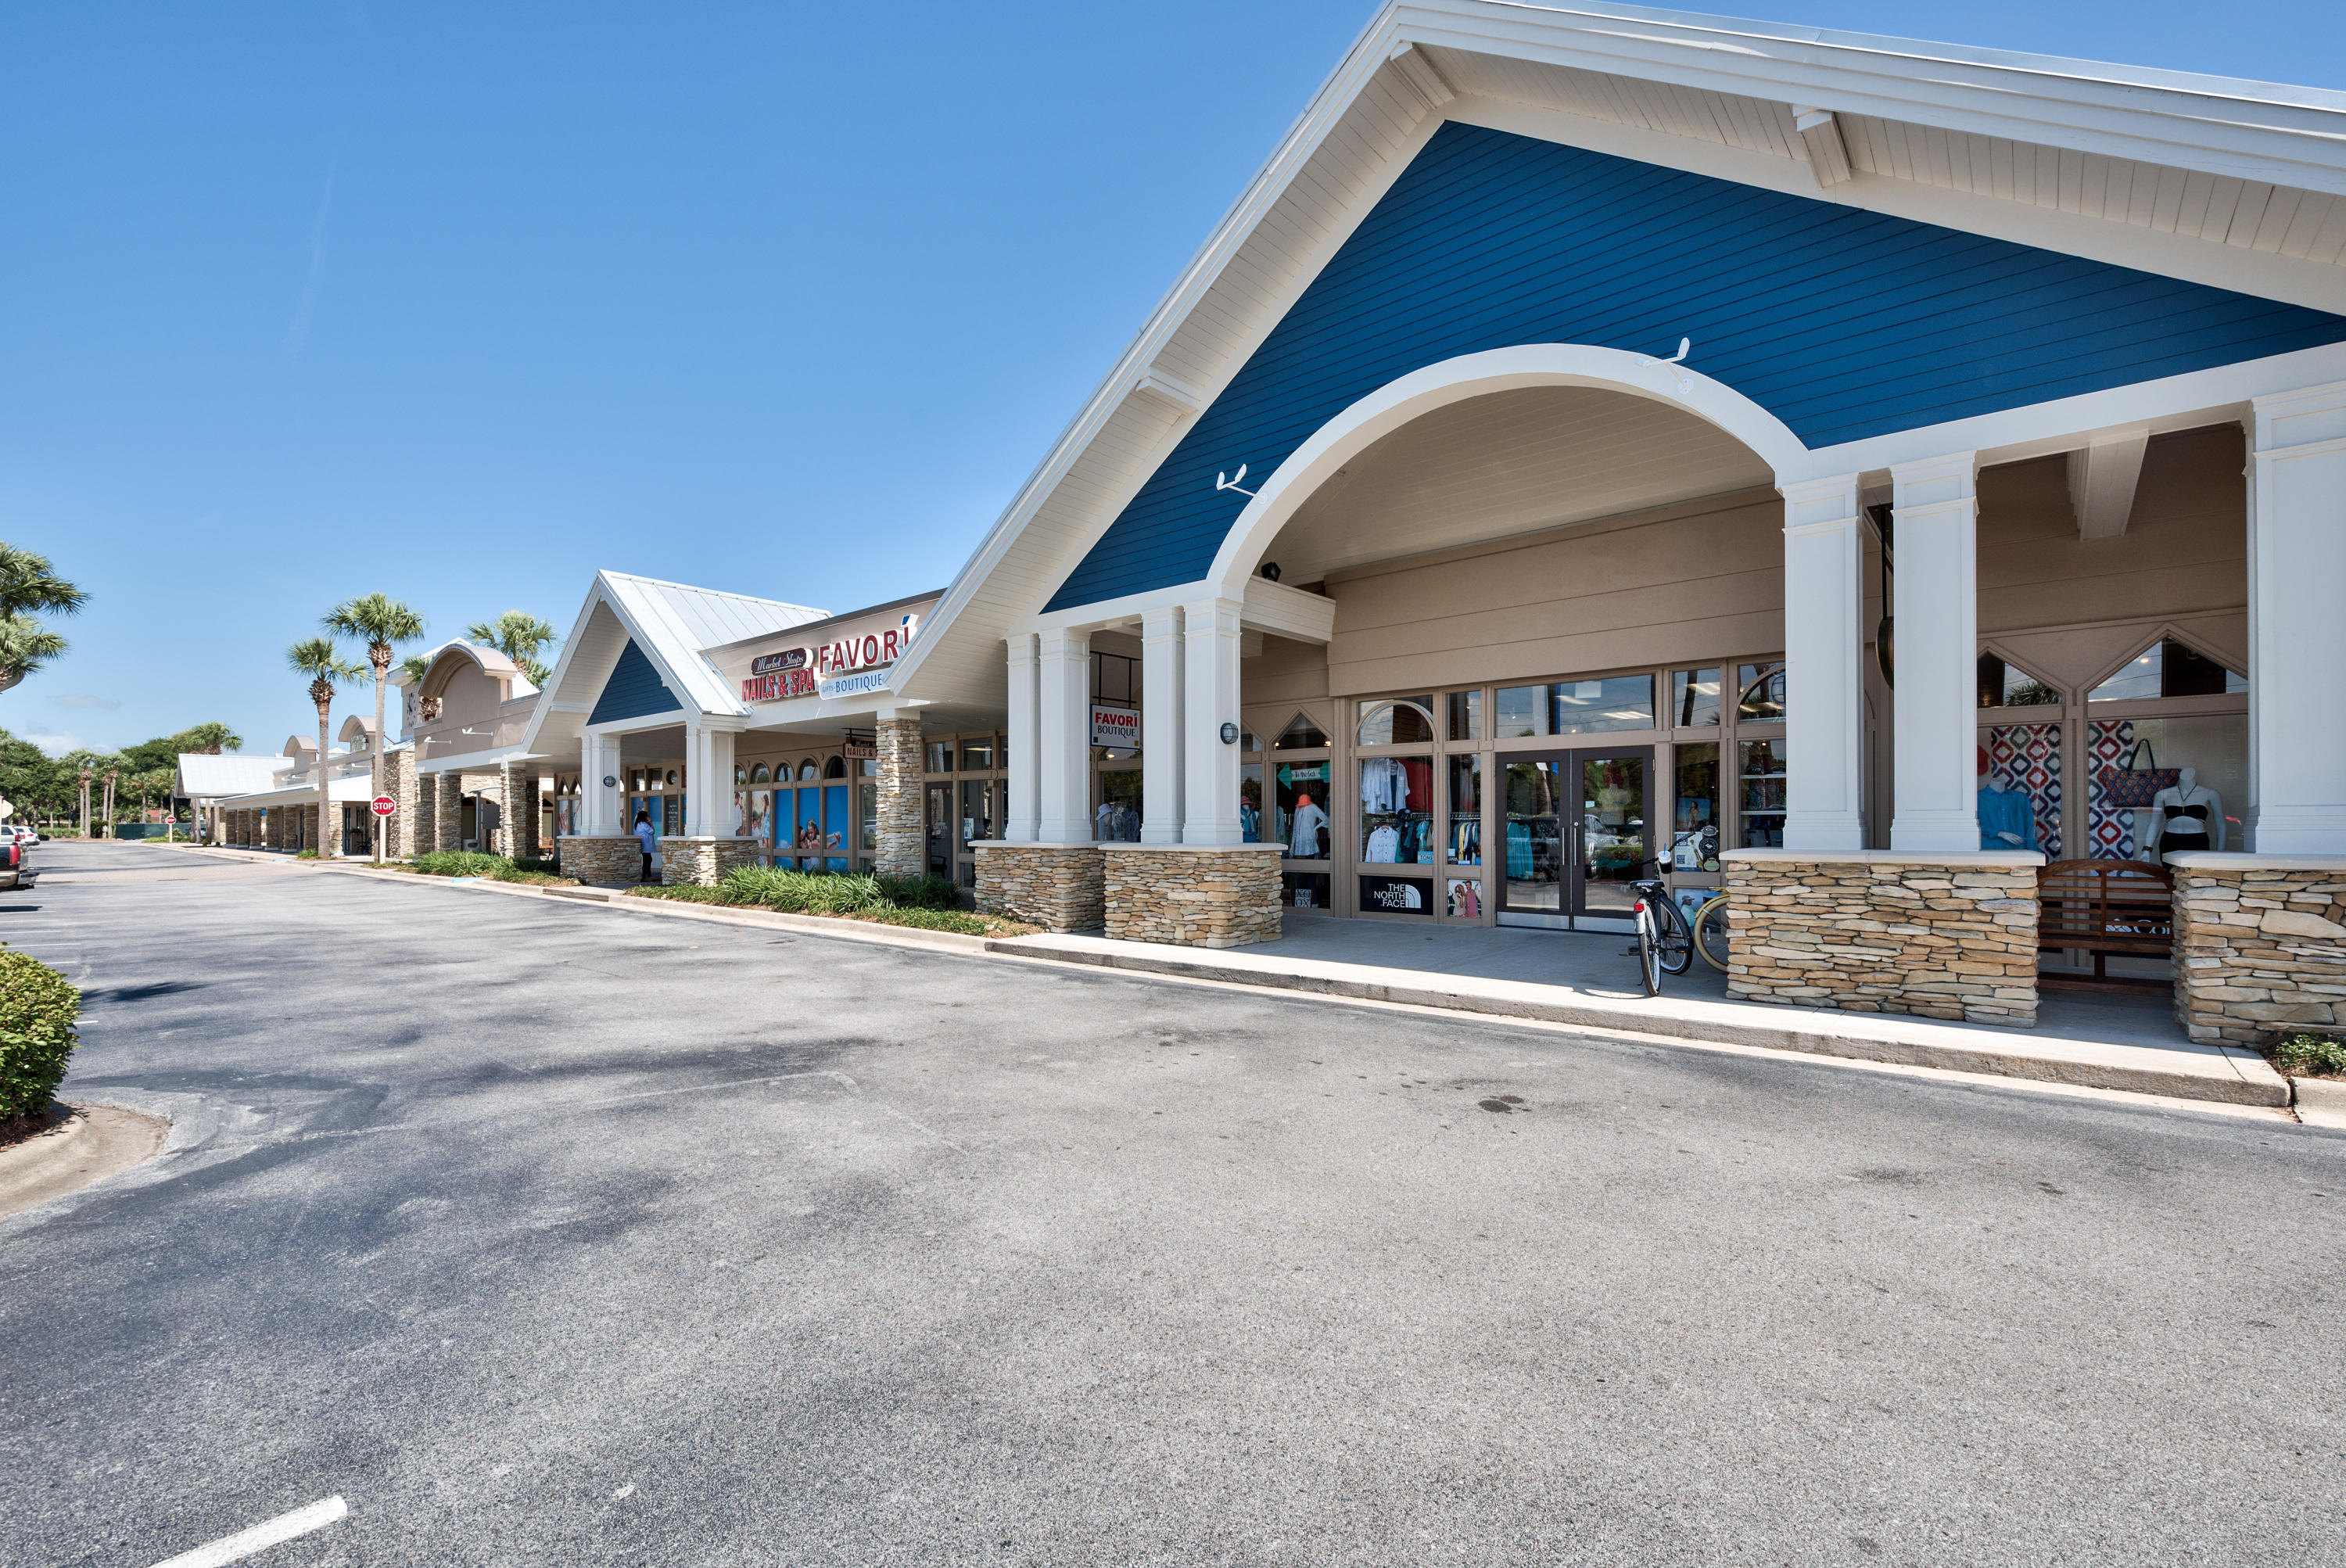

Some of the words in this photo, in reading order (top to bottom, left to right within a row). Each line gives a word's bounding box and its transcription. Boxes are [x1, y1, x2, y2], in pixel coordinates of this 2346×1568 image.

[755, 657, 781, 670] Market
[782, 651, 804, 666] Shops
[742, 675, 774, 701] NAILS
[778, 674, 787, 696] &
[791, 667, 814, 694] SPA
[836, 673, 883, 693] BOUTIQUE
[1097, 725, 1135, 738] BOUTIQUE
[847, 747, 866, 757] NAILS
[1387, 883, 1405, 892] THE
[1373, 891, 1405, 900] NORTH
[1382, 899, 1405, 908] FACE
